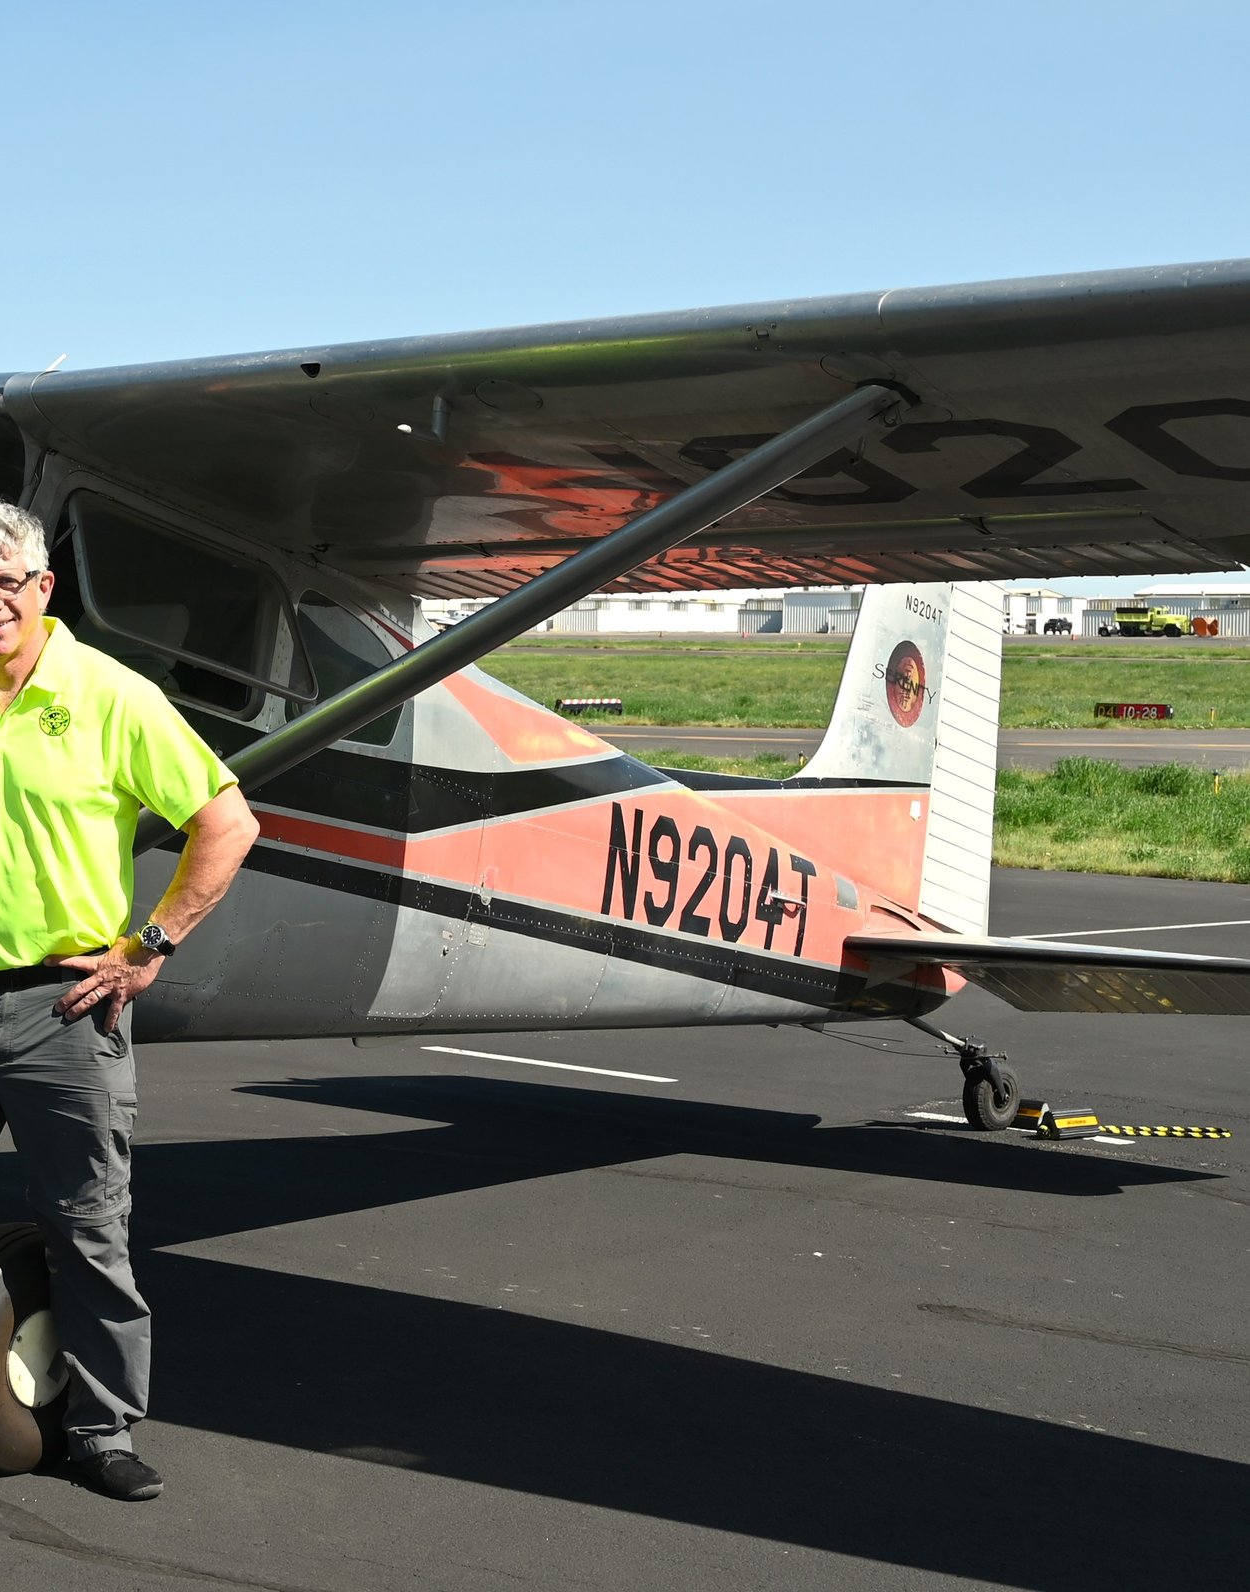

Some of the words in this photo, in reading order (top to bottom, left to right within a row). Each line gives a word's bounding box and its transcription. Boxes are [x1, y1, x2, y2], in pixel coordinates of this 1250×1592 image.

[905, 594, 943, 626] N9204T
[1123, 705, 1158, 719] 10-28
[601, 801, 817, 957] N9204T
